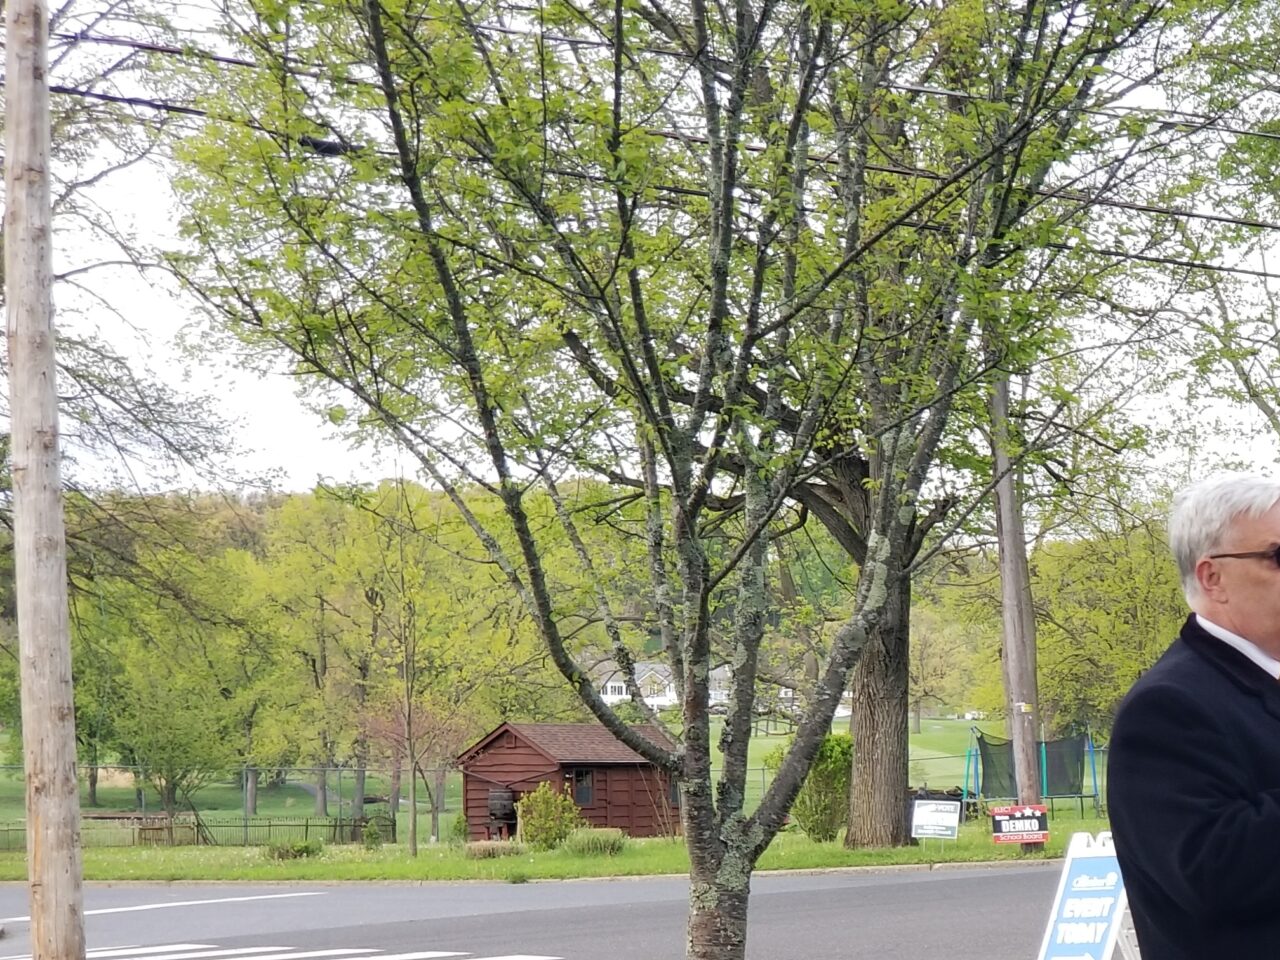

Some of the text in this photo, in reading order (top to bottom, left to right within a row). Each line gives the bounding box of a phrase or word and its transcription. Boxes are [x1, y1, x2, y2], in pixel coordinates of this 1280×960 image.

[1001, 819, 1039, 832] DEMKO
[1063, 897, 1115, 918] EVENT
[1056, 922, 1109, 945] TODAY
